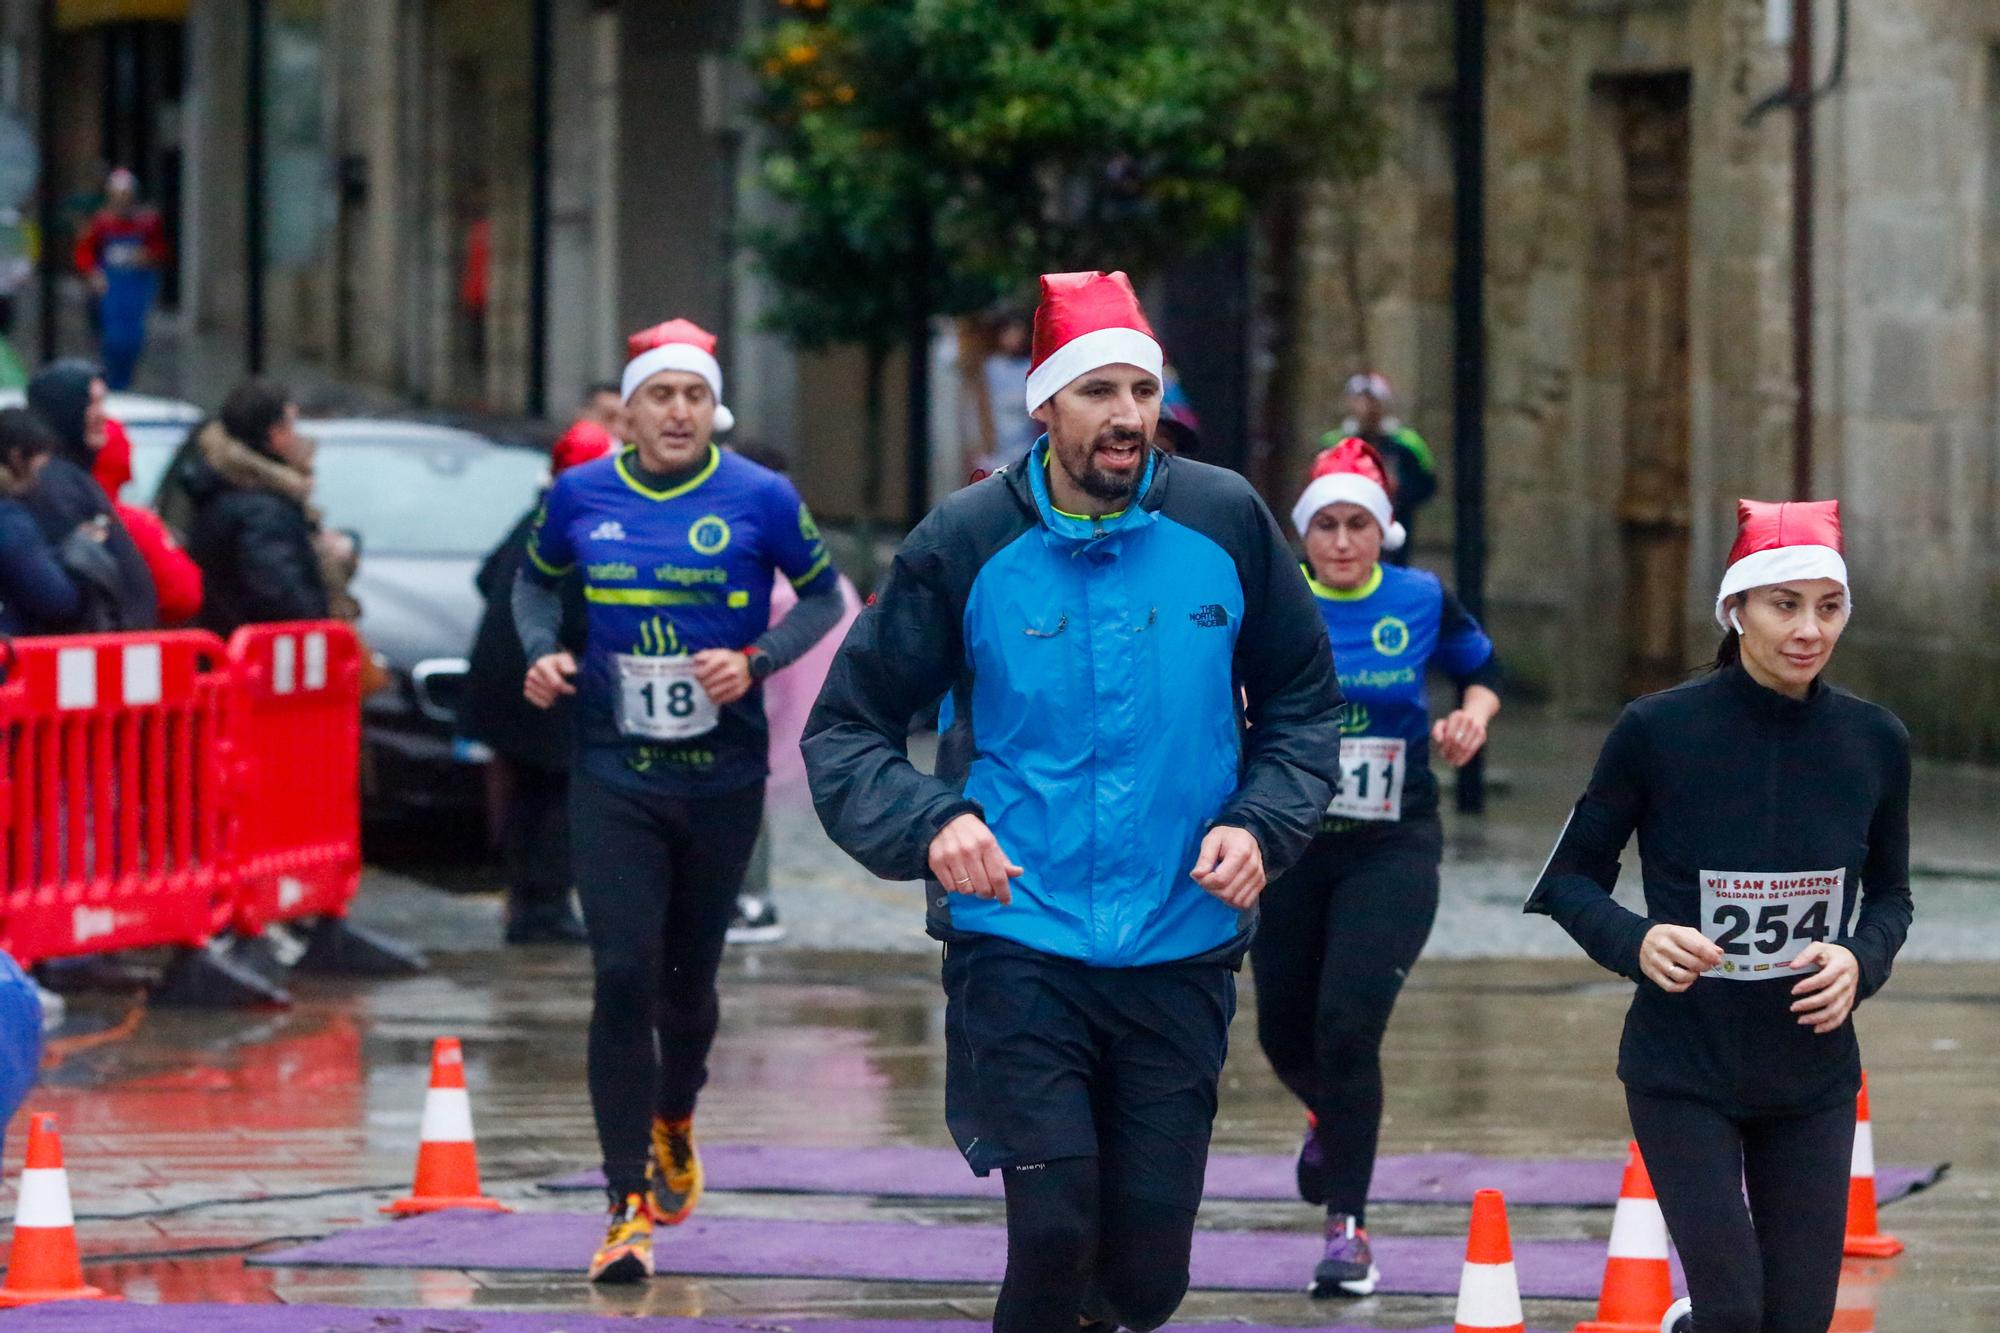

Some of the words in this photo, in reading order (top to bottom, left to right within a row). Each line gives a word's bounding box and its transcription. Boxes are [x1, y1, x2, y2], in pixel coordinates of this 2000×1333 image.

[1200, 605, 1216, 613] THE
[1189, 613, 1216, 621] NORTH
[1197, 620, 1217, 628] FACE
[640, 681, 695, 717] 18
[1336, 762, 1393, 799] 11
[1707, 878, 1727, 889] VII
[1733, 879, 1764, 890] SAN
[1716, 890, 1764, 899] SOLIDARIA
[1782, 889, 1831, 898] CAMBADOS
[1712, 900, 1830, 956] 254
